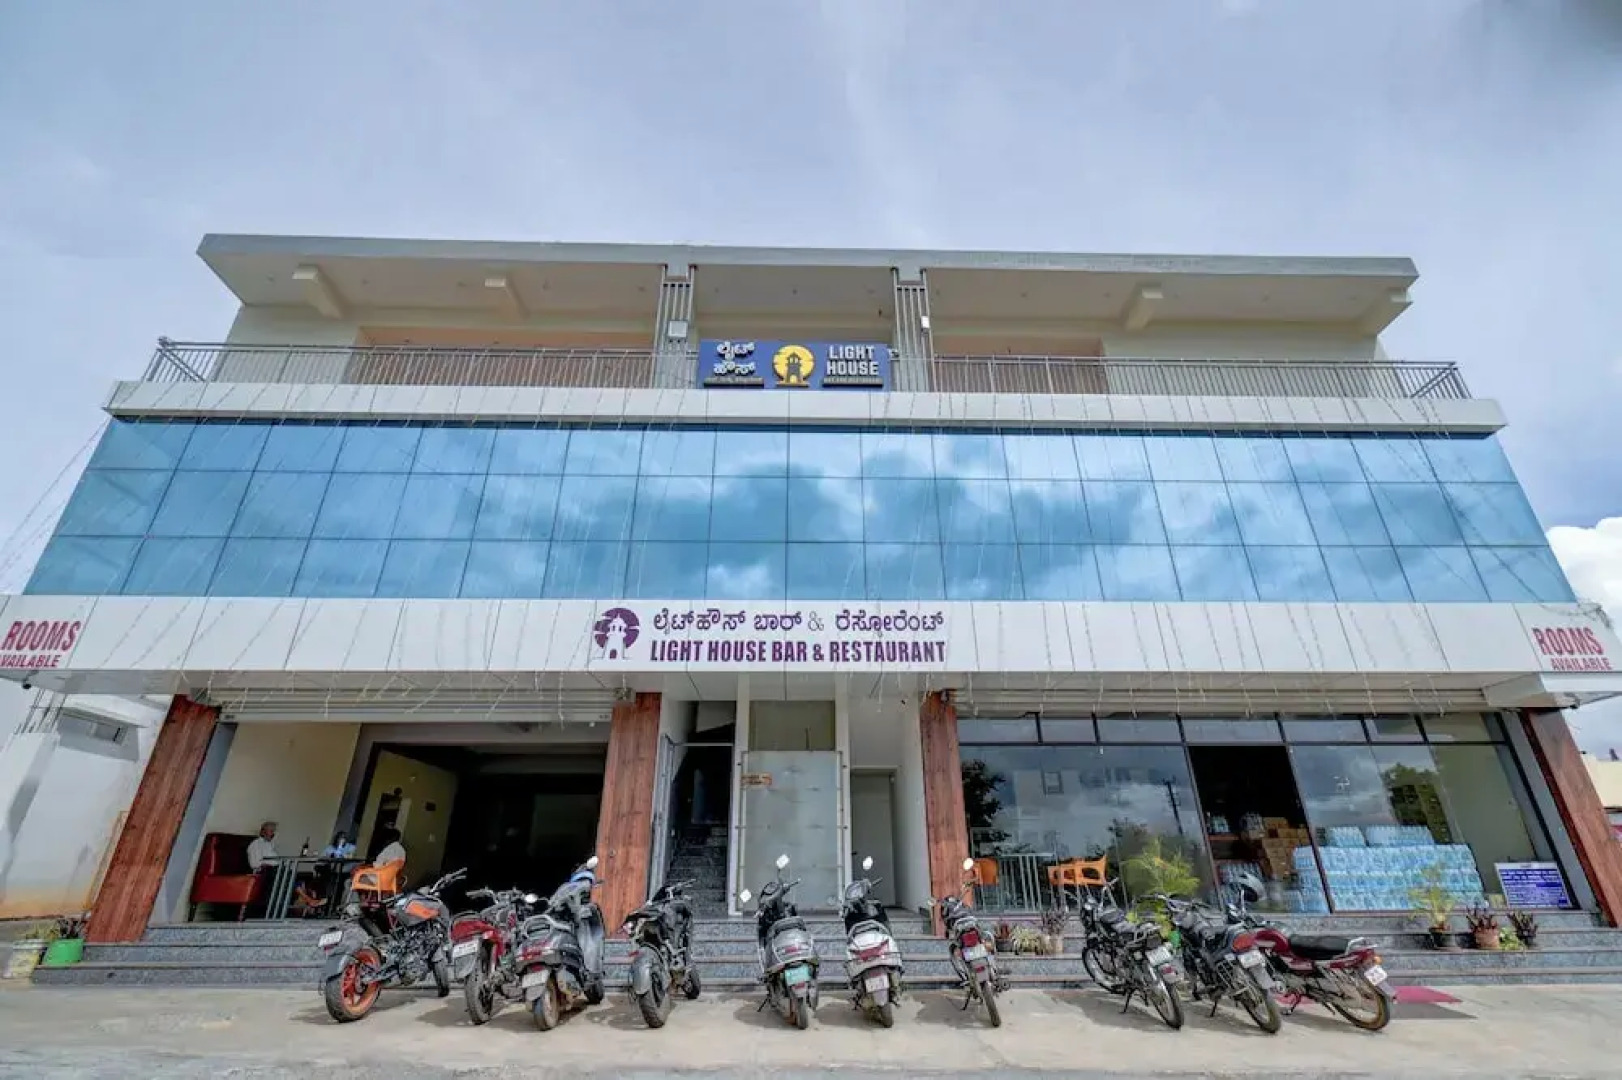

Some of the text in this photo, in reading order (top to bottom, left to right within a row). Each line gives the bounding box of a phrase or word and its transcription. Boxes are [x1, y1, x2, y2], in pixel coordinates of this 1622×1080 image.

[829, 345, 875, 360] LIGHT
[826, 360, 879, 376] HOUSE
[754, 610, 802, 631] ಬಾರ್
[807, 610, 825, 631] &
[1, 620, 82, 651] ROOMS
[1532, 627, 1604, 655] ROOMS
[650, 640, 946, 662] LIGHT HOUSE BAR & RESTAURANT
[0, 654, 62, 667] VAILABLE
[1550, 657, 1613, 671] AVAILABLE
